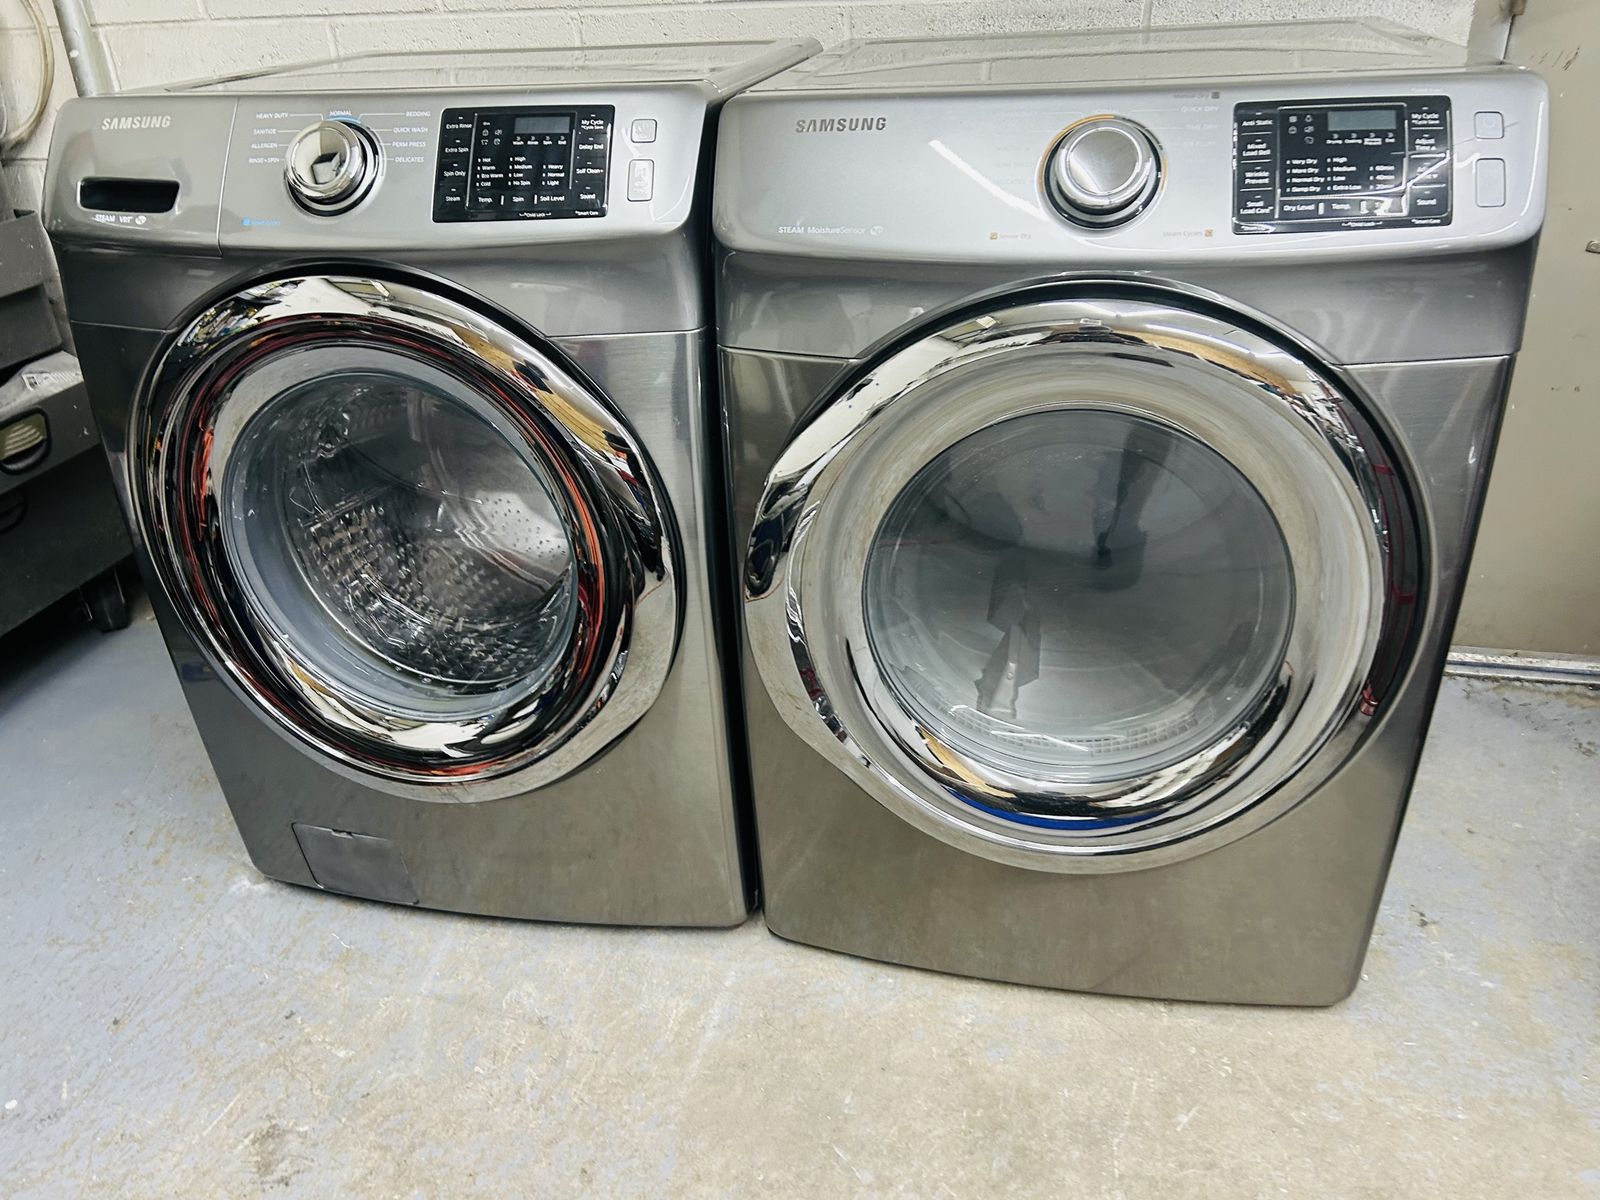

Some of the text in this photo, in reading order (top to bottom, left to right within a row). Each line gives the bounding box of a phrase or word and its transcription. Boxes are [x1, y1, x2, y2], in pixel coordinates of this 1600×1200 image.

[102, 115, 171, 130] SAMSUNG
[795, 117, 887, 133] SAMSUNG
[1416, 198, 1437, 206] Sound
[778, 226, 804, 234] STEAM
